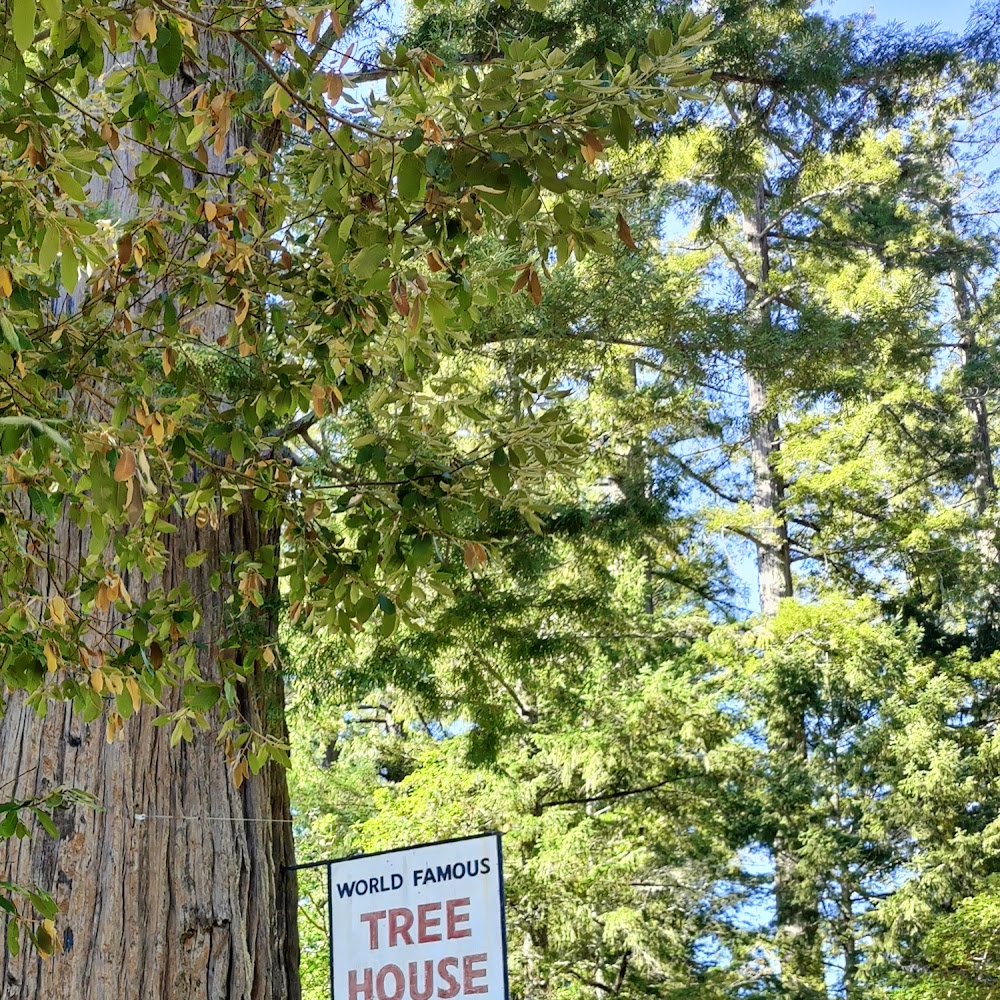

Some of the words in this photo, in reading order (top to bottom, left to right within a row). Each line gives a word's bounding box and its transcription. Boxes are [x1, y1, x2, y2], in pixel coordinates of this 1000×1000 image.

[336, 873, 403, 899] WORLD
[413, 858, 491, 887] FAMOUS
[360, 897, 472, 950] TREE
